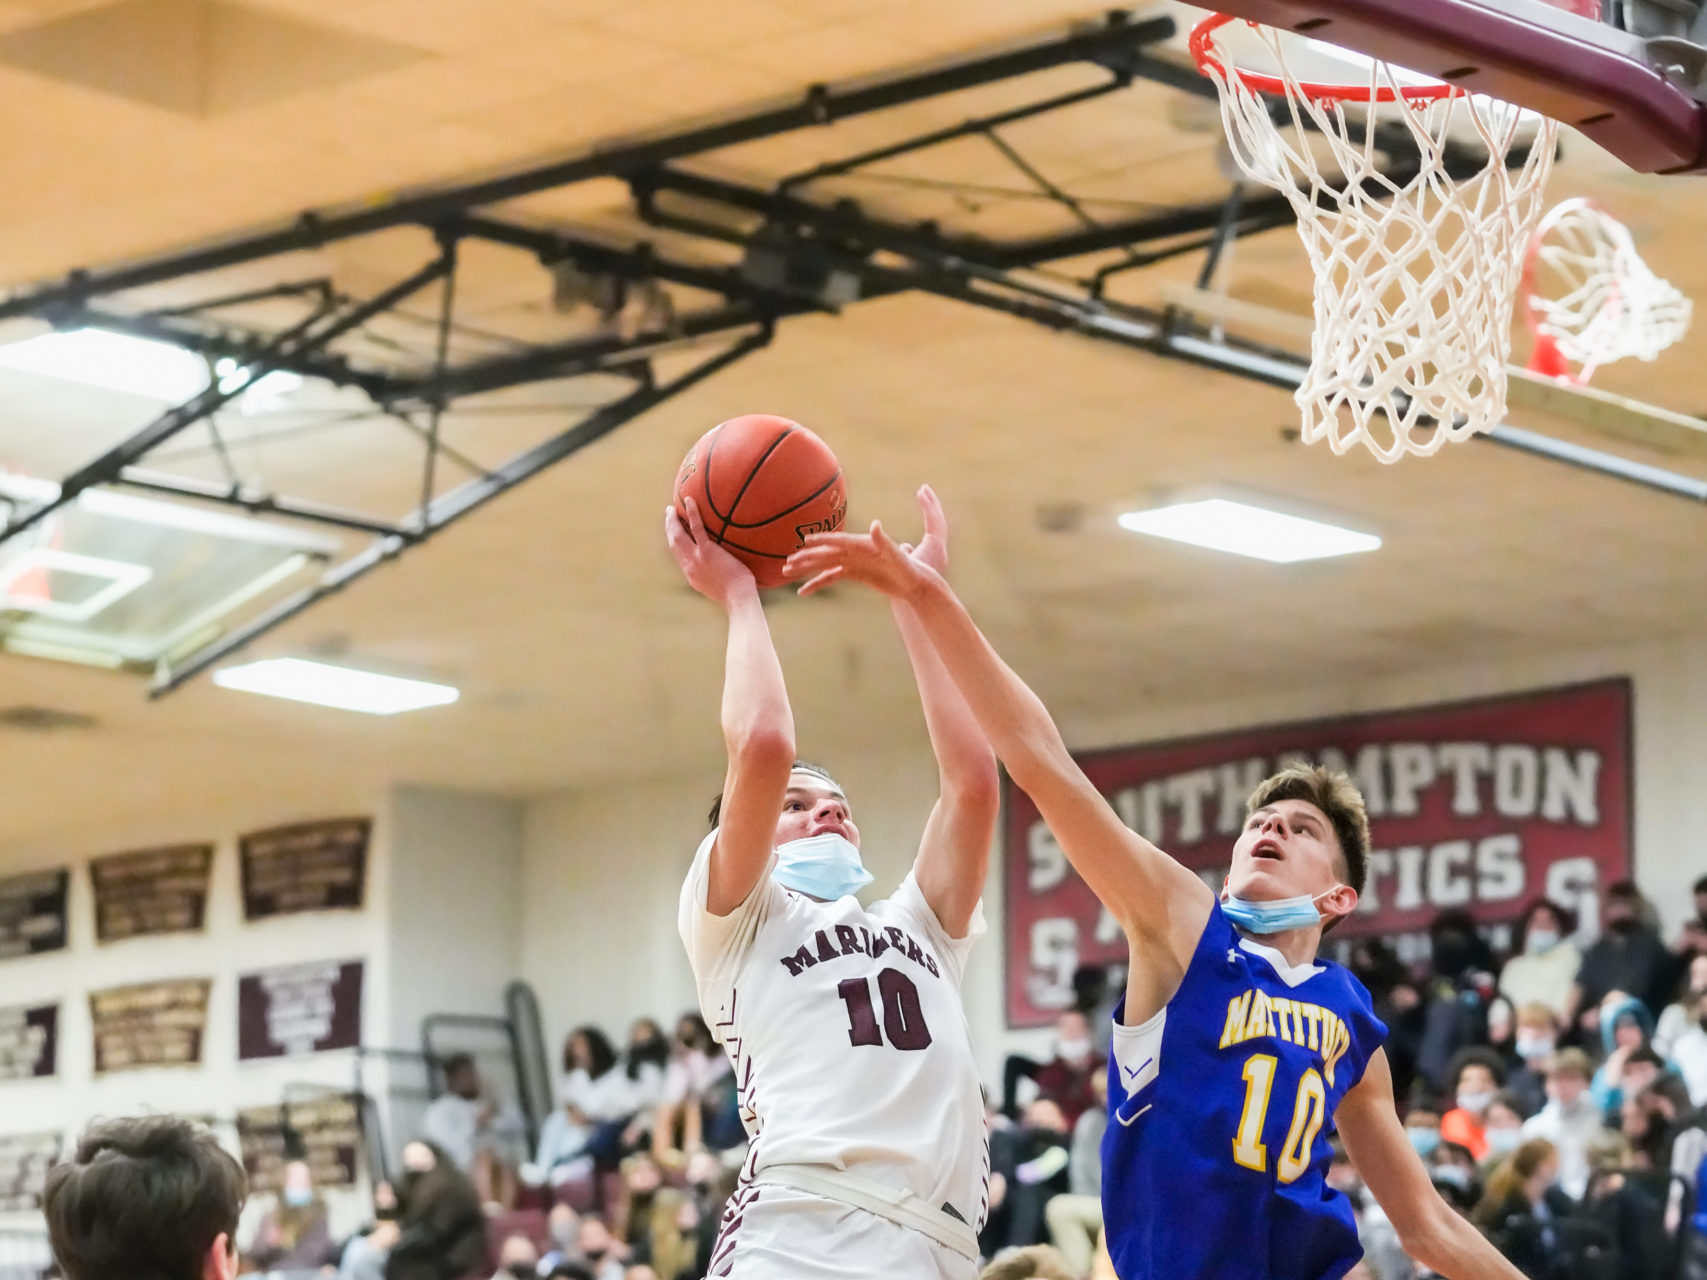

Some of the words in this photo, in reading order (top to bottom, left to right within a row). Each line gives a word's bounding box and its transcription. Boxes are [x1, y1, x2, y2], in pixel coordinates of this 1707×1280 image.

[795, 498, 848, 549] SPALD
[1028, 743, 1599, 896] SUTHMPTON
[837, 967, 933, 1051] 10
[1218, 988, 1351, 1088] MATTITUC
[1231, 1053, 1326, 1184] 10
